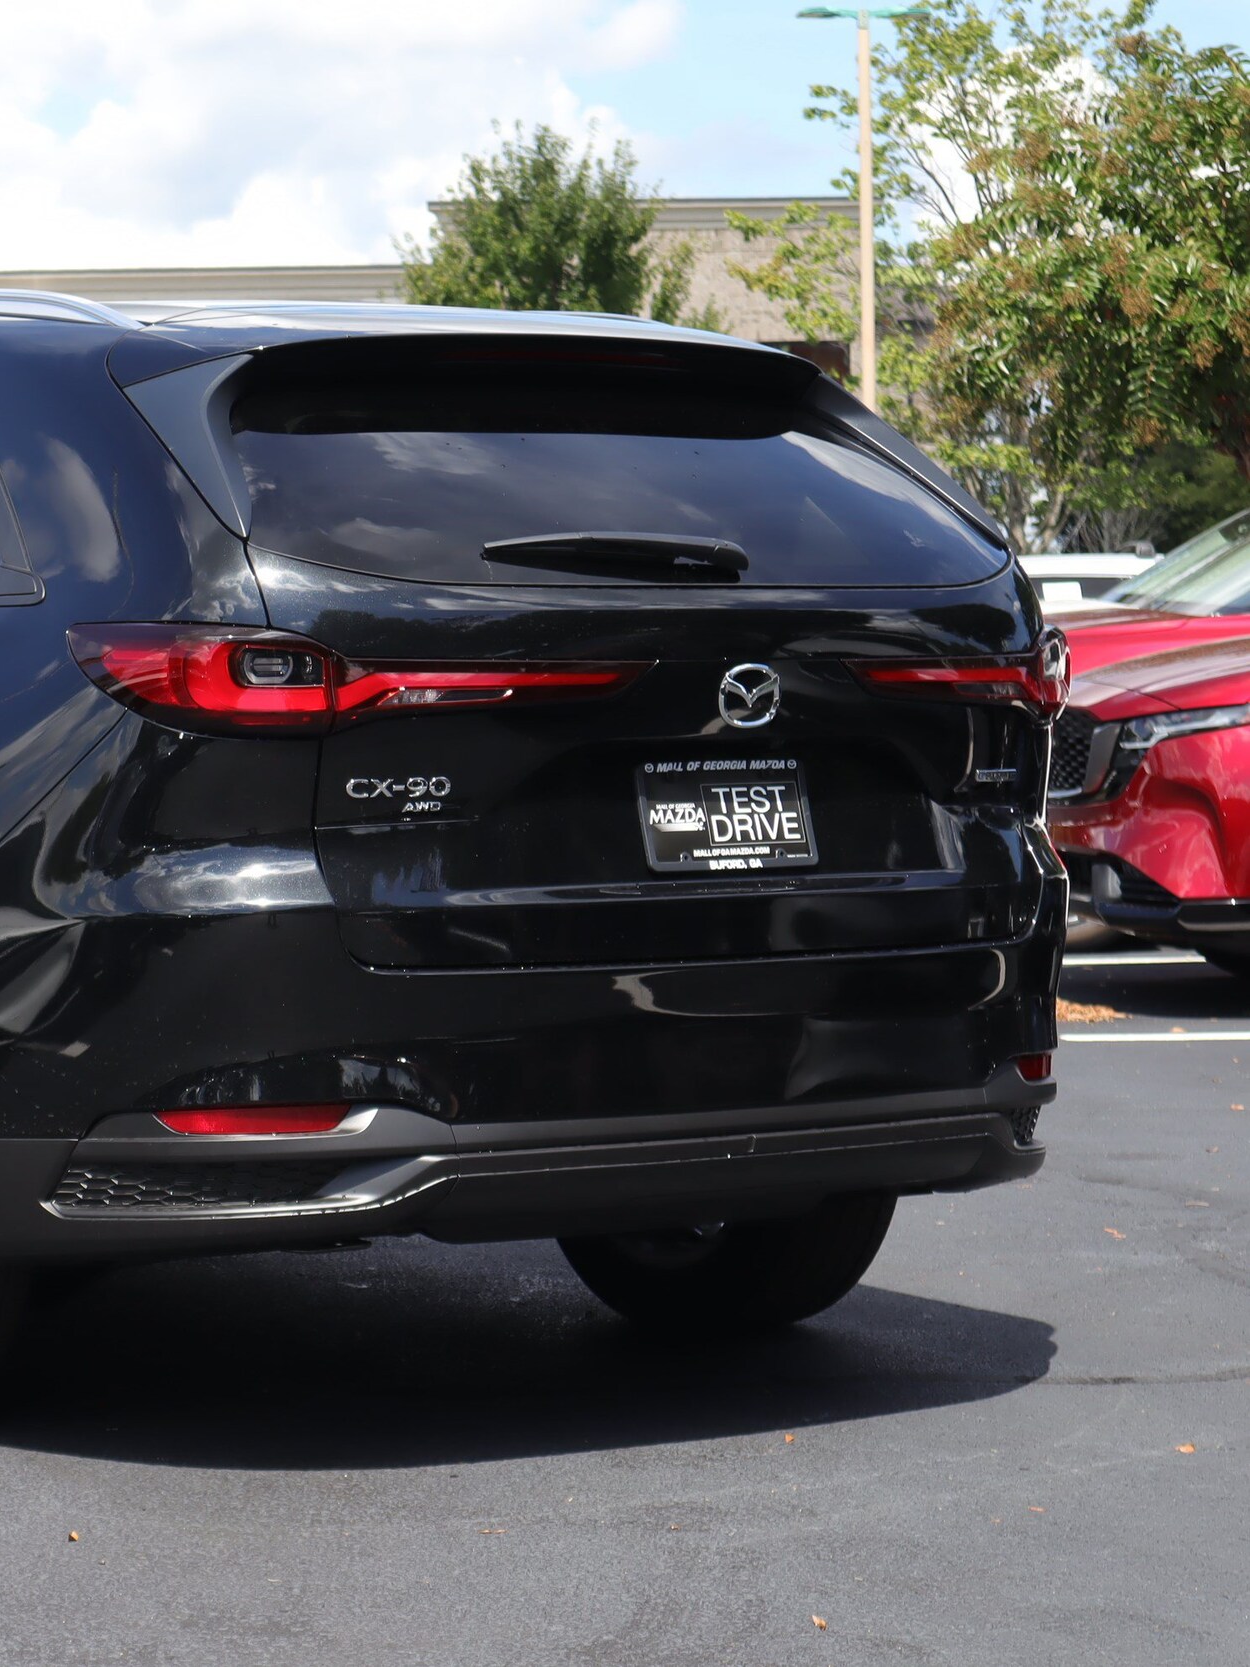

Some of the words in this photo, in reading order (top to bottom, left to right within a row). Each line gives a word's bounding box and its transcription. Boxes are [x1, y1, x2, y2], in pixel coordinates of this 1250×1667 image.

[656, 762, 683, 773] MALL
[686, 761, 701, 771] OF
[703, 760, 747, 771] GEORGIA
[749, 759, 785, 770] MAZDA
[345, 776, 451, 799] CX-90
[401, 801, 442, 813] AWD
[711, 785, 786, 814] TEST
[649, 807, 706, 825] MAZDA
[710, 812, 802, 842] DRIVE
[749, 858, 764, 869] GA
